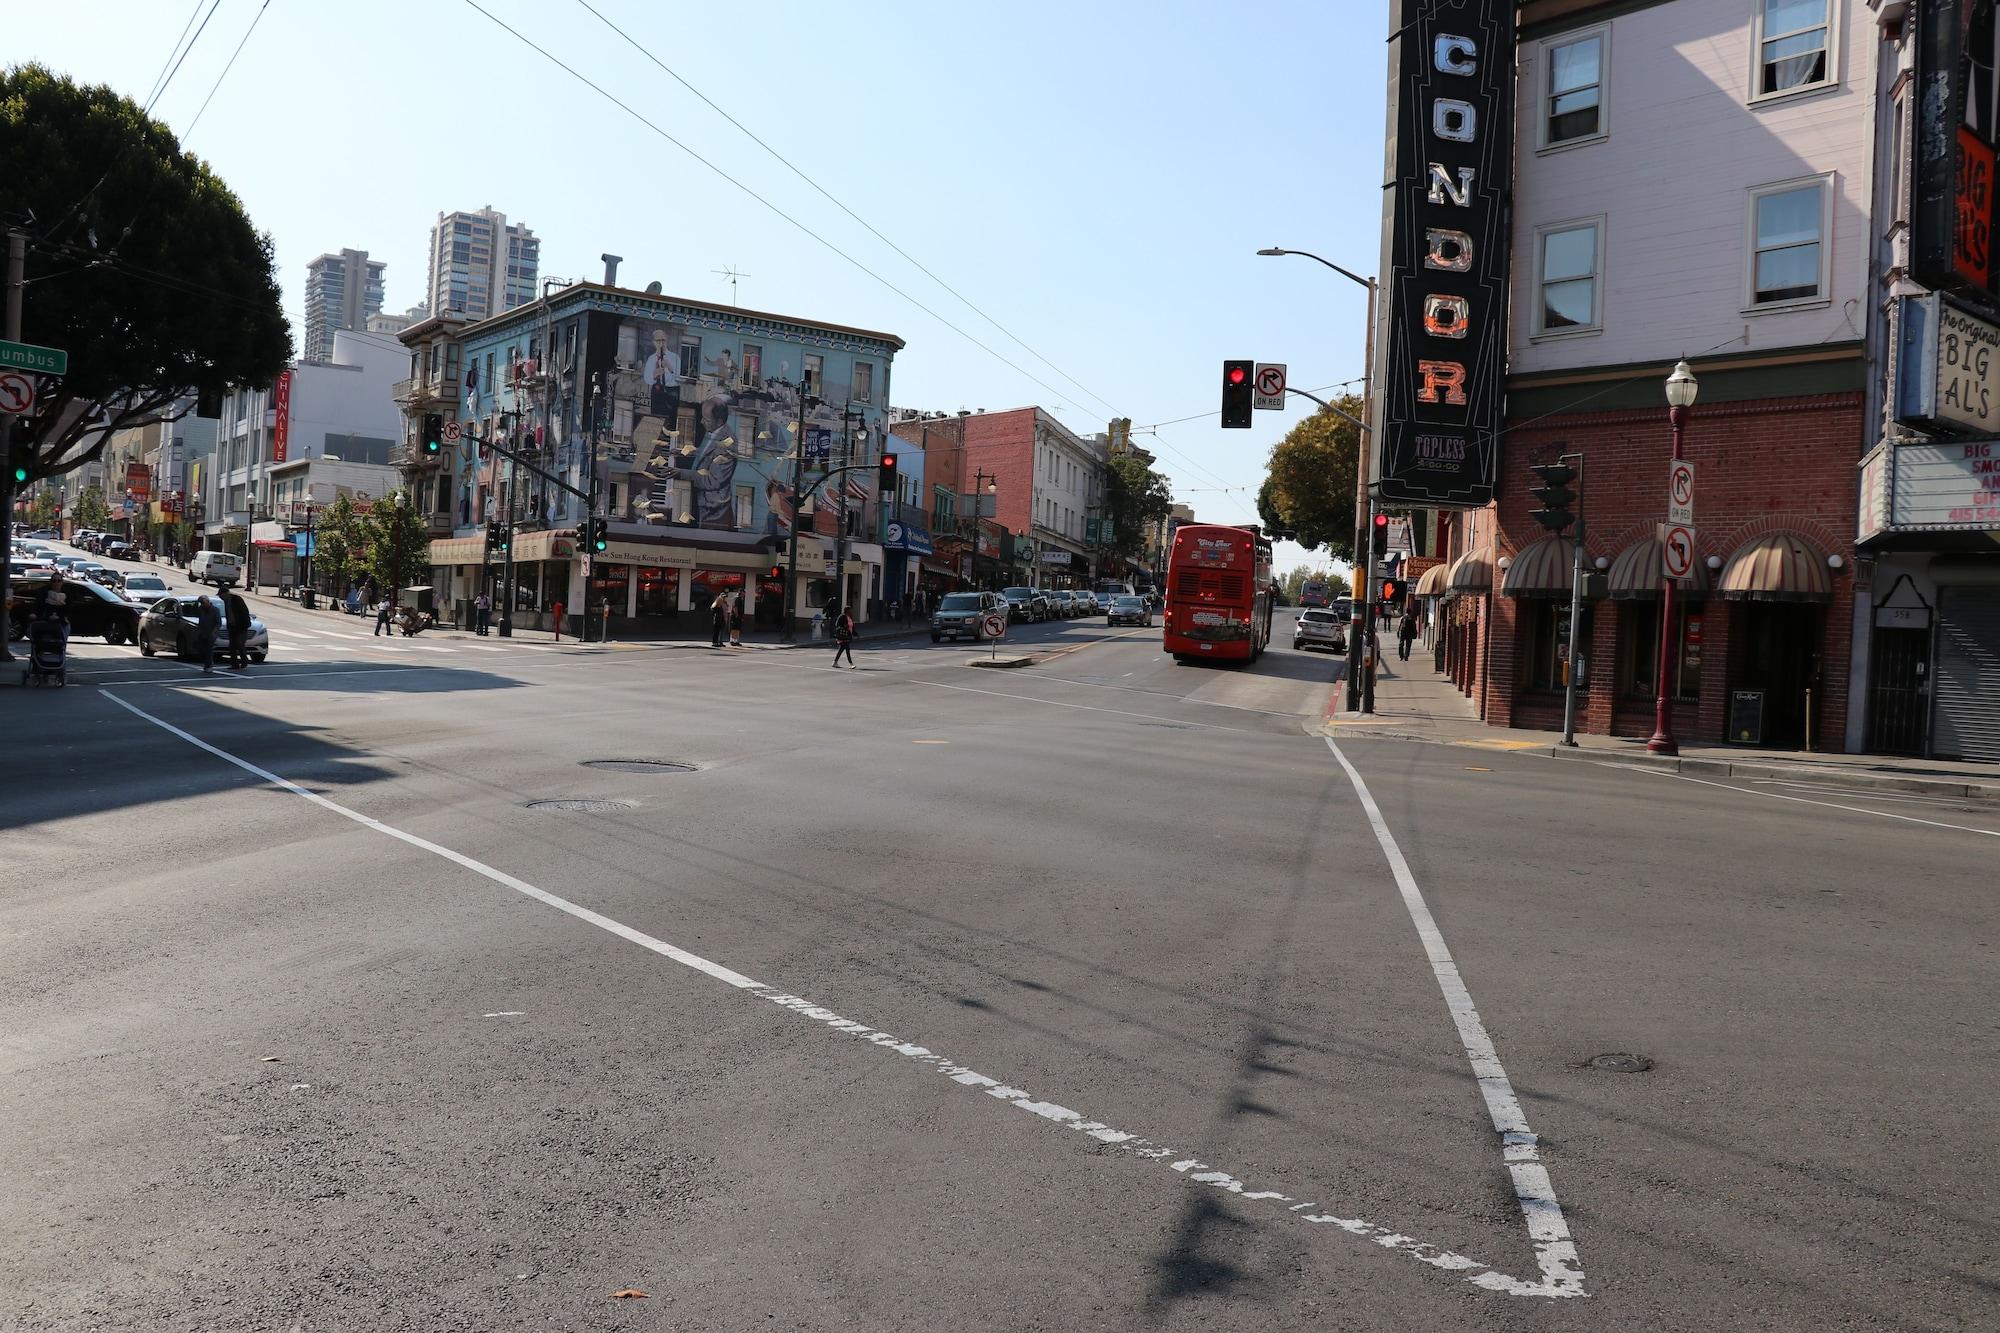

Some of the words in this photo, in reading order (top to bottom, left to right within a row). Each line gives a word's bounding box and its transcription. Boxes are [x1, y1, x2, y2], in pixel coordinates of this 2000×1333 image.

[1417, 32, 1478, 405] CONDOR
[1, 348, 55, 368] umbus
[1945, 333, 1990, 382] BIG
[1257, 397, 1267, 406] ON
[1269, 397, 1282, 407] RED
[1944, 377, 1990, 419] AL'S
[1415, 436, 1466, 460] TOPLESS
[1964, 444, 1991, 458] BIG
[1672, 506, 1679, 518] ON
[1680, 508, 1691, 520] RED
[624, 553, 641, 562] Hong
[642, 554, 659, 563] Kong
[659, 555, 692, 565] Restaurant
